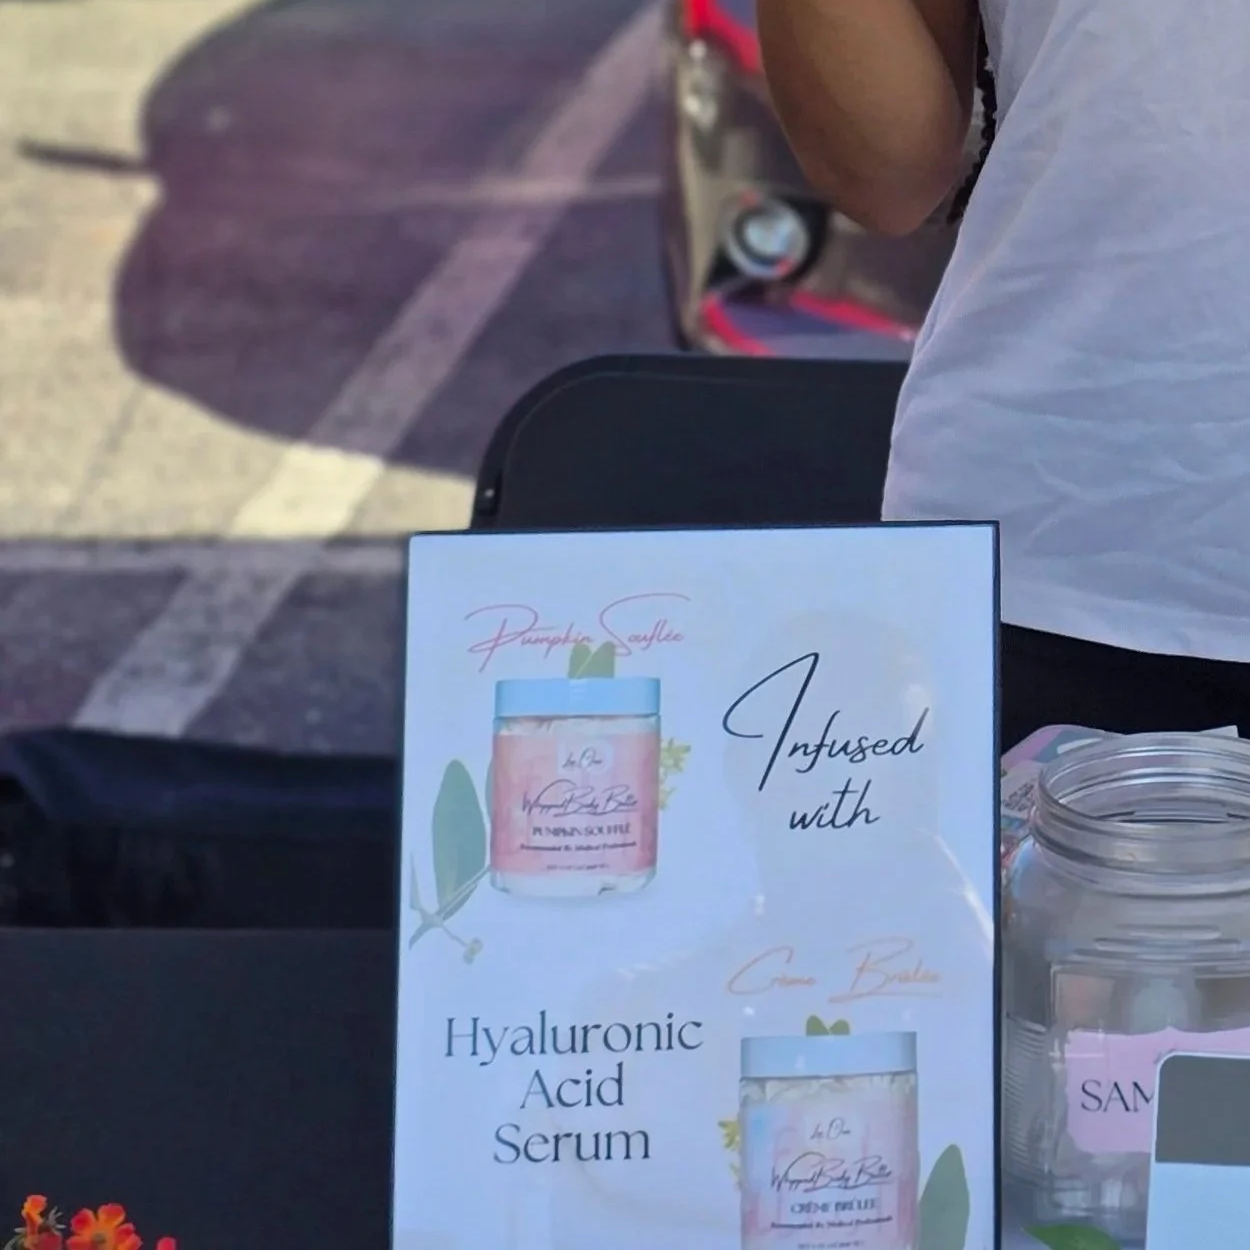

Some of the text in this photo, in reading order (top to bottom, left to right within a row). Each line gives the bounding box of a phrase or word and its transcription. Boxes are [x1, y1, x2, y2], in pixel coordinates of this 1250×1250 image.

[463, 604, 594, 673] Pumpkin
[722, 651, 930, 793] Infused
[789, 776, 881, 830] with
[444, 1009, 705, 1067] Hyaluronic
[519, 1061, 625, 1110] Acid
[1080, 1078, 1155, 1113] SAM
[493, 1122, 652, 1165] Serum
